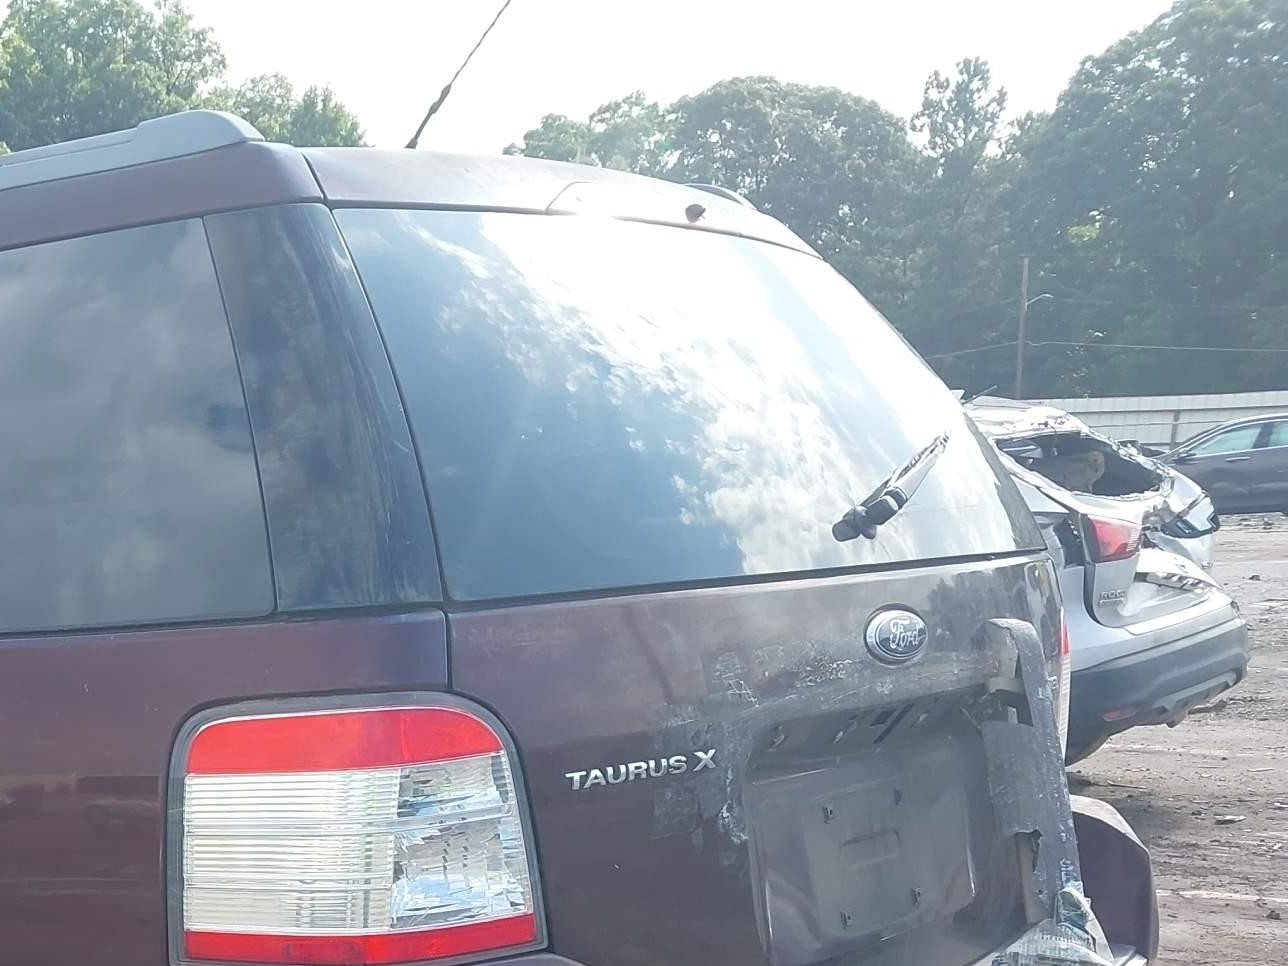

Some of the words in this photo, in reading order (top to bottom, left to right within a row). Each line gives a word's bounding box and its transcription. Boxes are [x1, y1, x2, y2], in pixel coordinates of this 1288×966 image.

[889, 618, 925, 649] Ford
[564, 755, 687, 790] TAURUS
[693, 749, 716, 772] X
